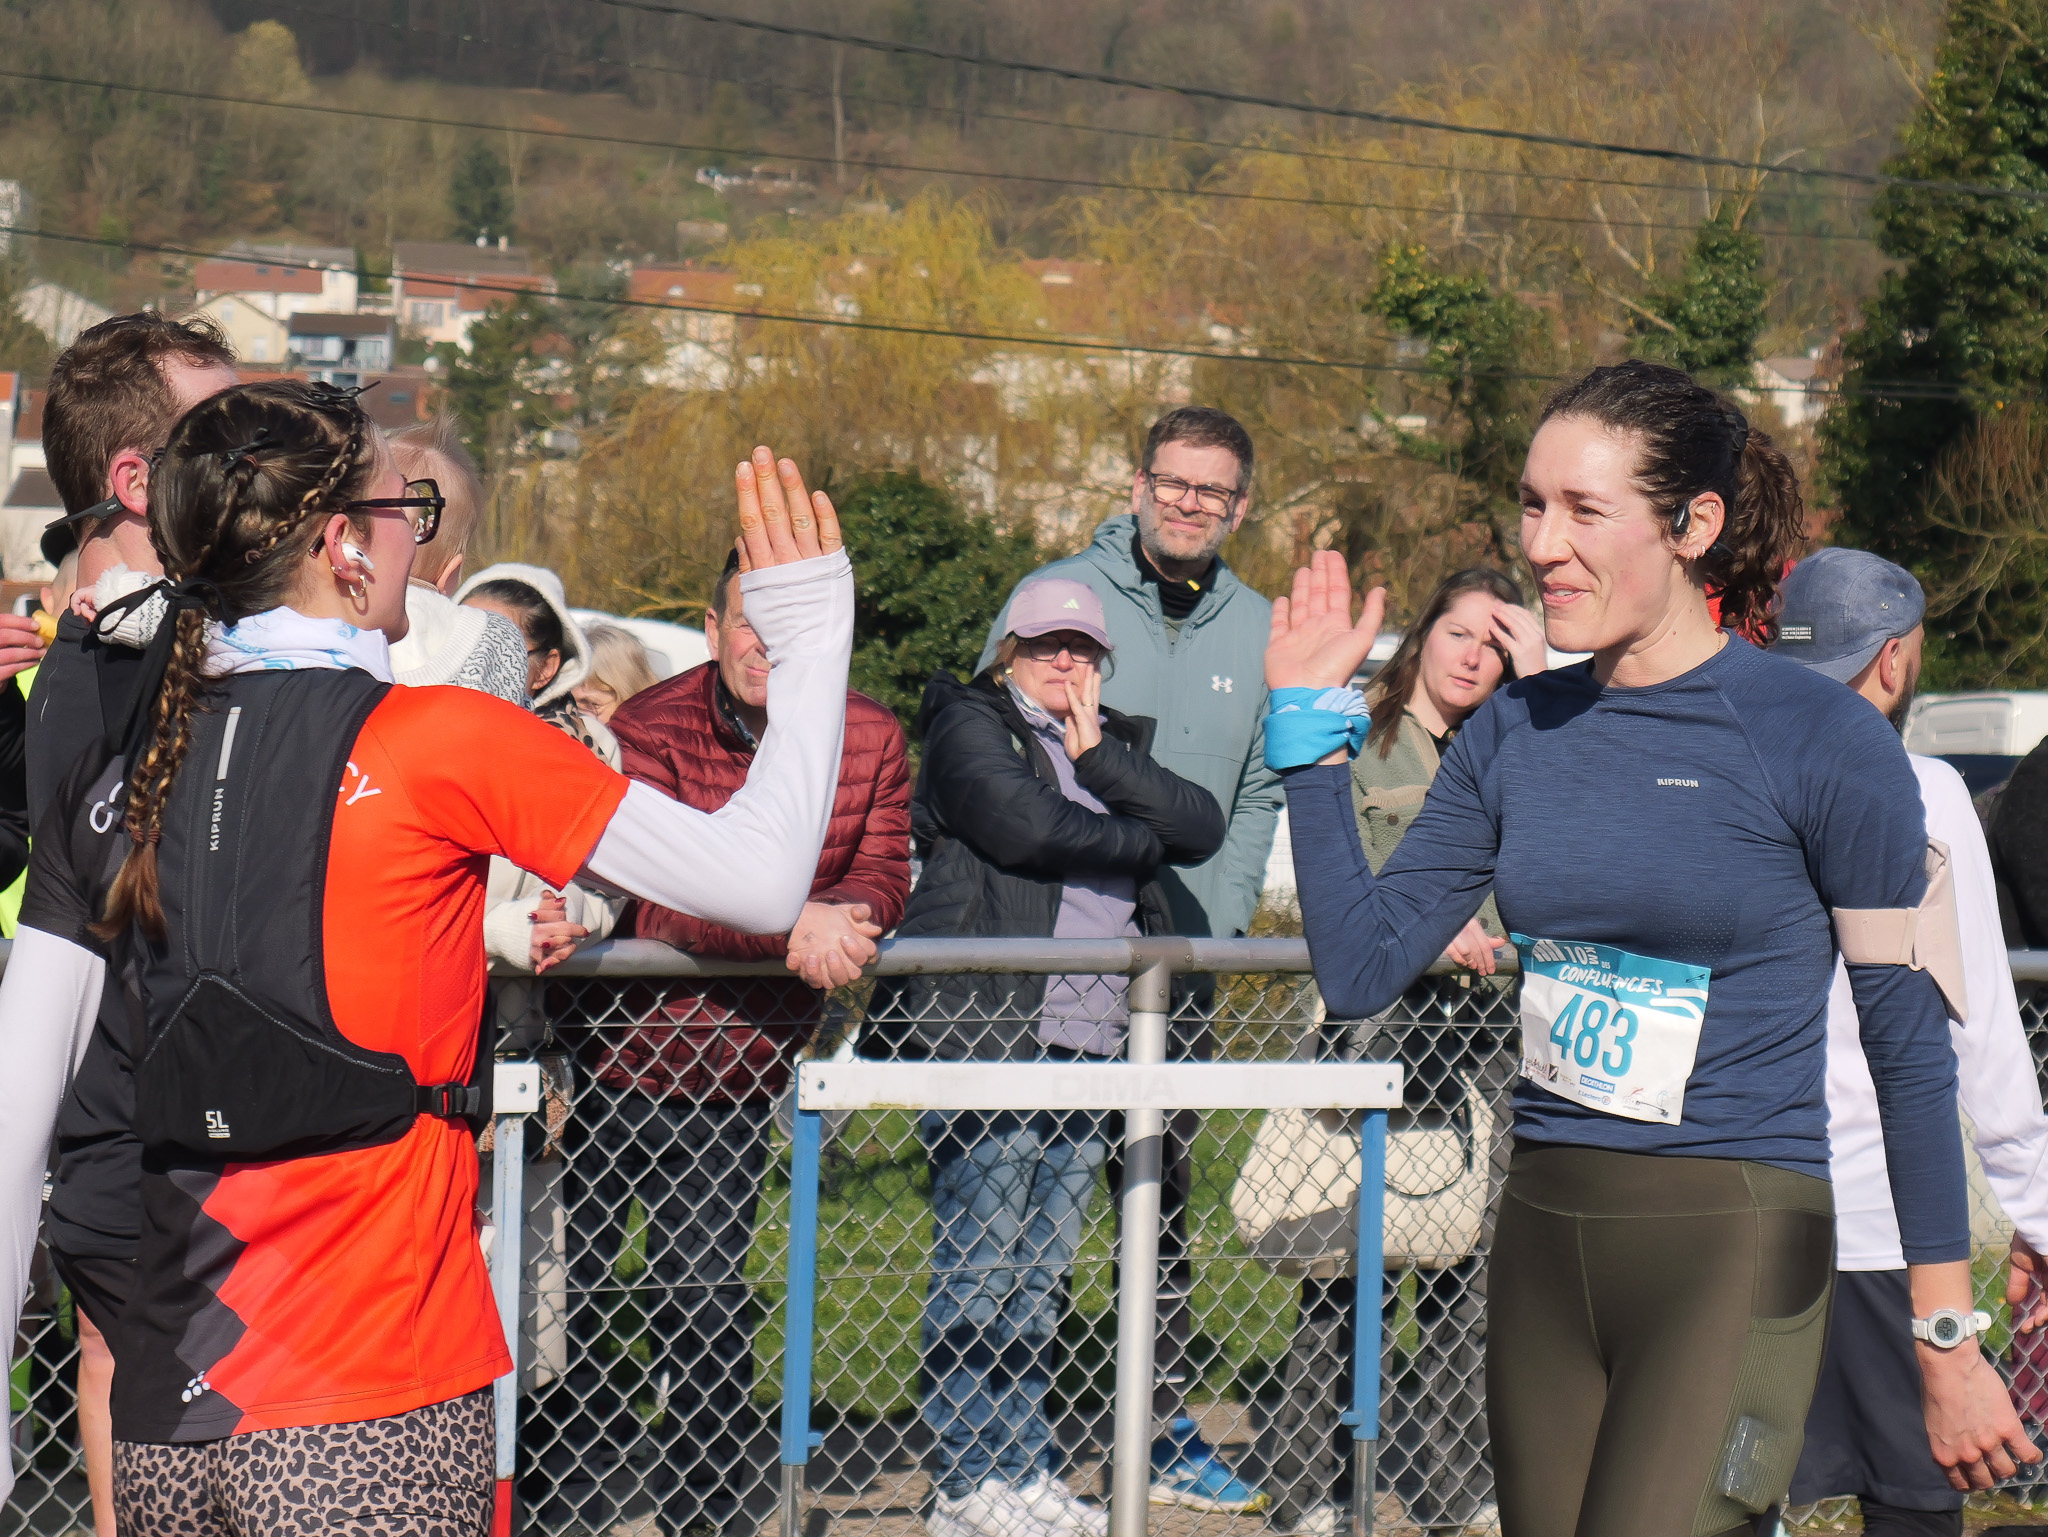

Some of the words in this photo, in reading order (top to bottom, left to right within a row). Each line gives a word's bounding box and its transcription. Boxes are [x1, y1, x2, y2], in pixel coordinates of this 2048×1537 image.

[1657, 778, 1699, 788] KIPRUN
[209, 788, 225, 851] KIPRUN
[1563, 946, 1588, 966] 10
[1584, 946, 1600, 965] KM
[1558, 964, 1664, 996] CONFLUENCES
[1550, 993, 1639, 1078] 483
[1051, 1072, 1178, 1103] DIMA
[1580, 1075, 1615, 1093] DECATHLON
[205, 1110, 230, 1129] 5L
